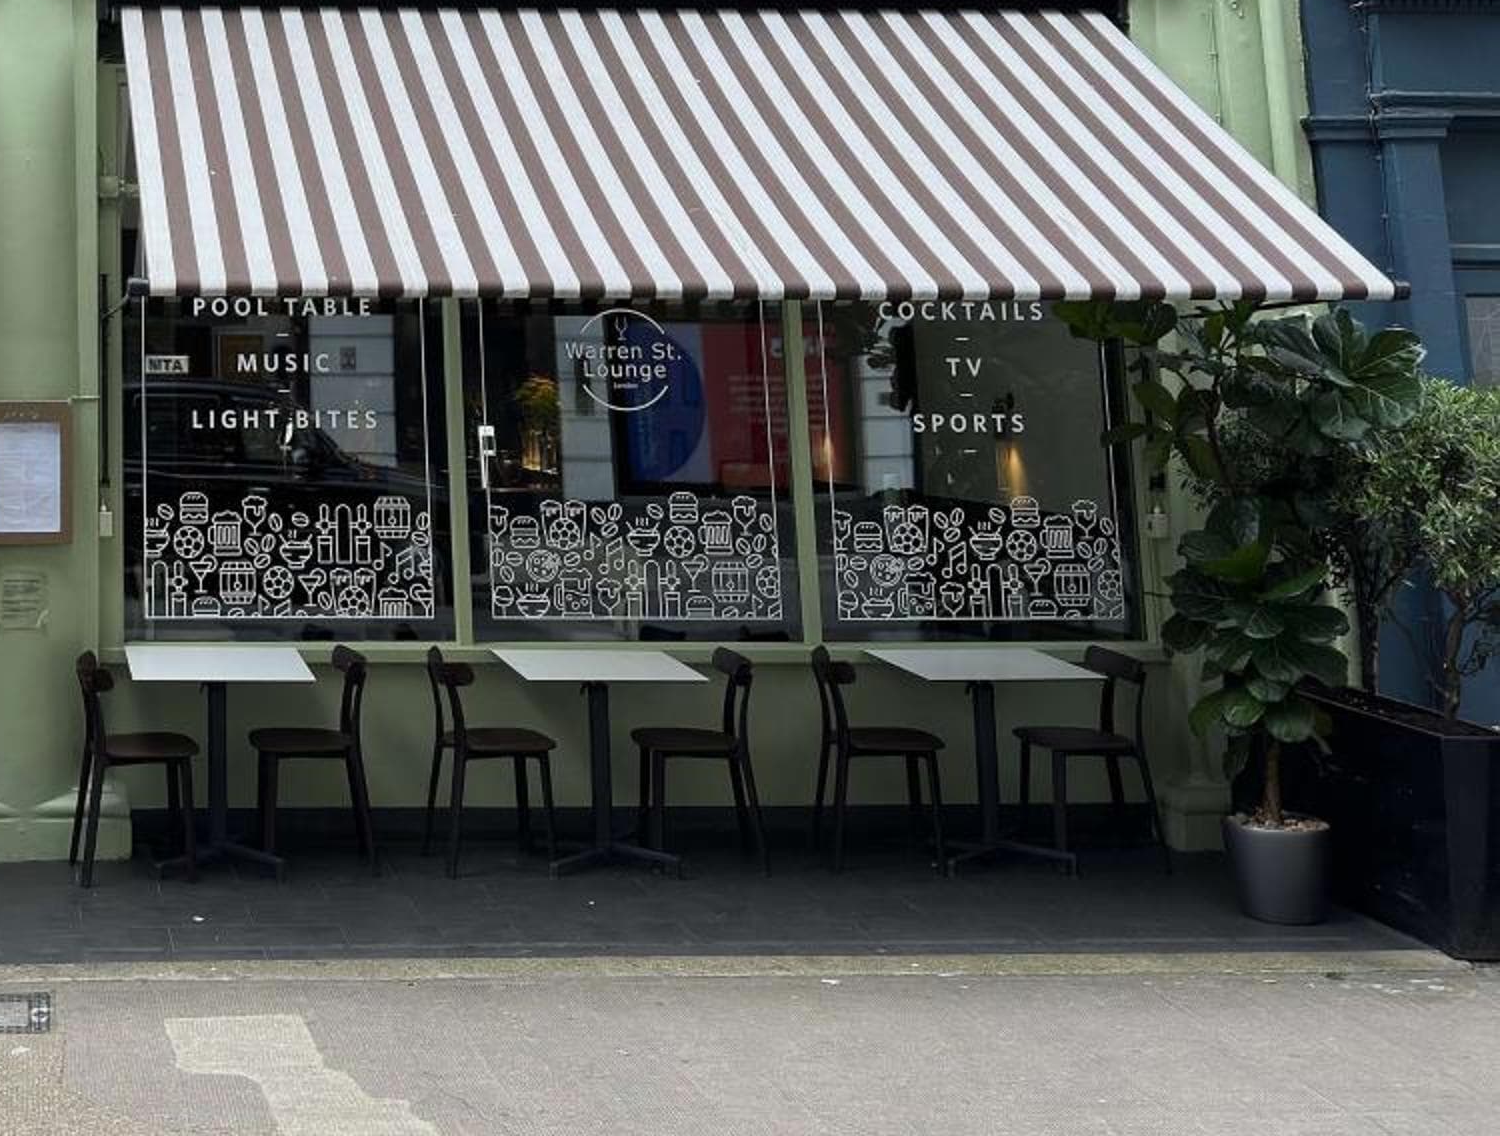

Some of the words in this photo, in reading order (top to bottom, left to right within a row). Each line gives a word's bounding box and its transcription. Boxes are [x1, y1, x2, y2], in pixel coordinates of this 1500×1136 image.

[192, 298, 269, 317] POOL
[283, 298, 372, 317] TABLE
[878, 301, 1044, 321] COCKTAILS
[564, 341, 643, 360] Warren
[652, 342, 683, 361] St.
[237, 353, 331, 373] MUSIC
[583, 360, 667, 383] Lounge
[945, 357, 982, 377] TV
[192, 409, 280, 429] LIGHT
[296, 409, 378, 429] BITES
[913, 413, 1026, 433] SPORTS
